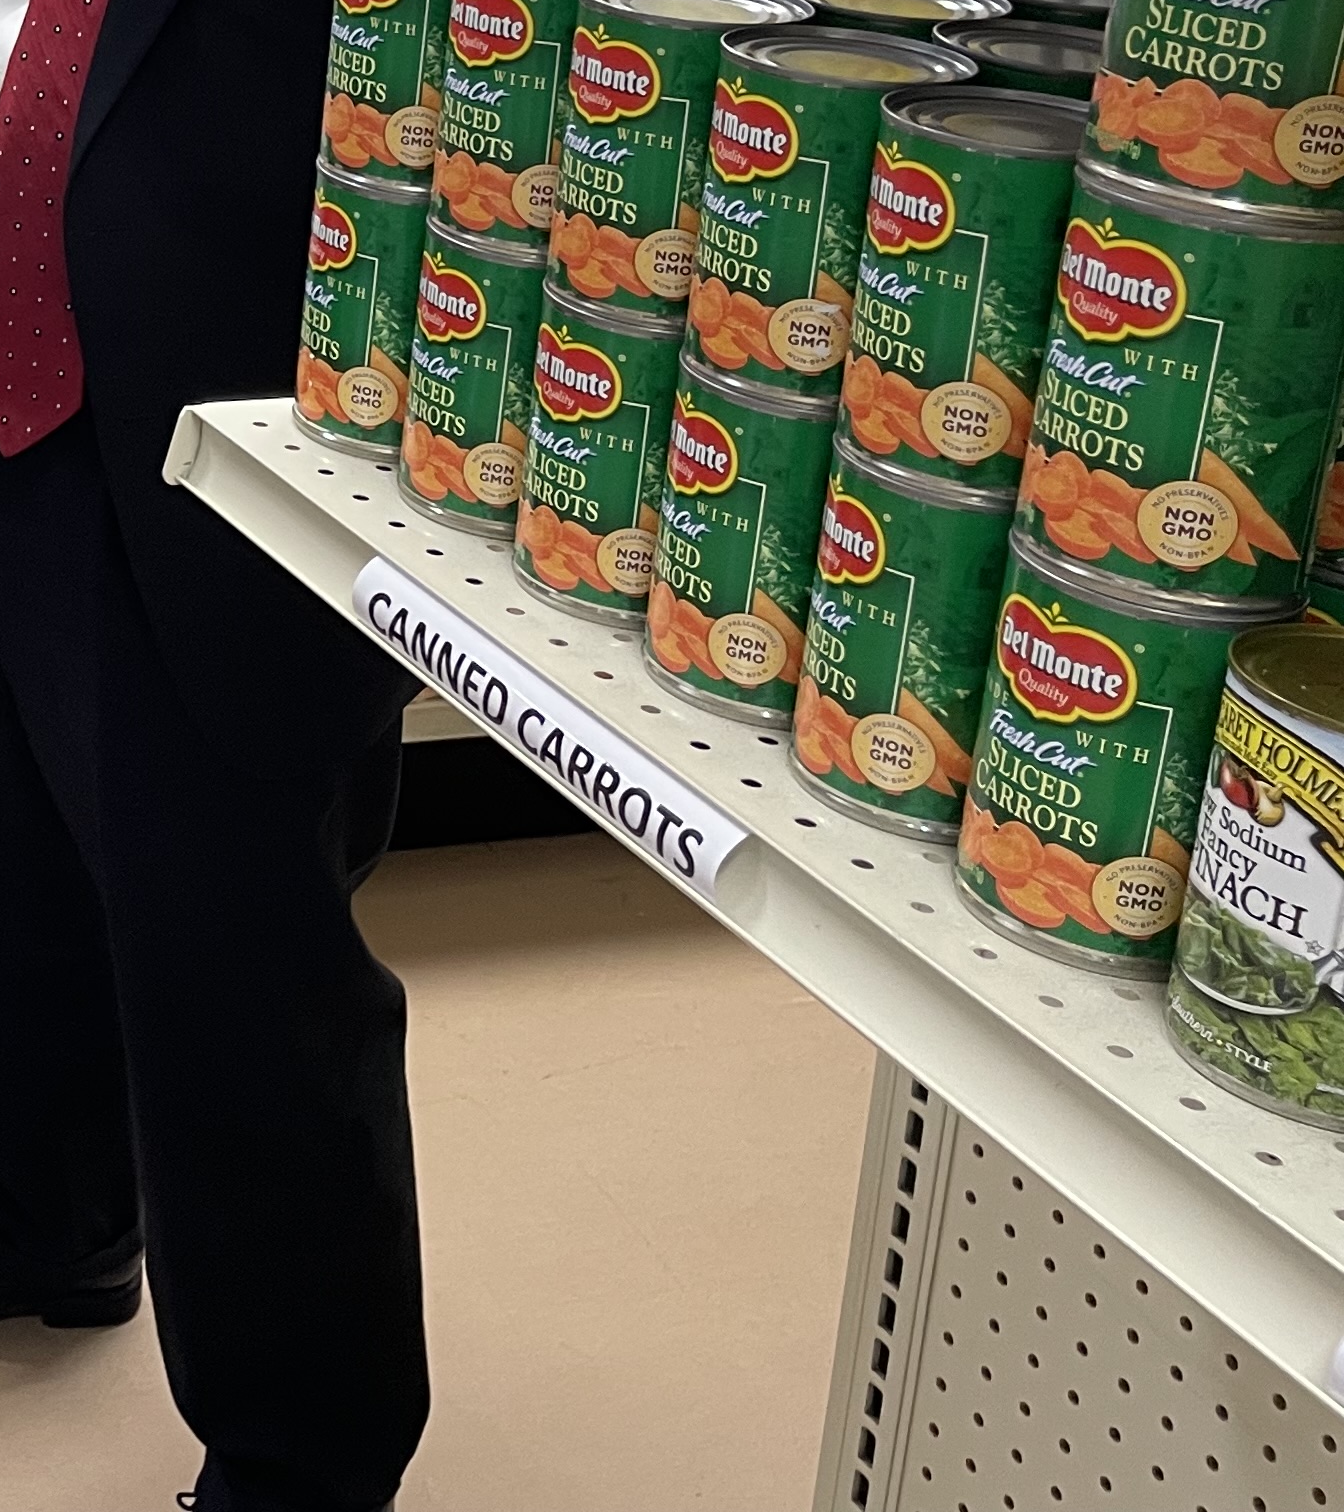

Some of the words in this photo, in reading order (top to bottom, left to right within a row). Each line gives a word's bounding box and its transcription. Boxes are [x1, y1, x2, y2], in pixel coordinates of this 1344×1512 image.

[370, 17, 417, 37] WITH
[465, 5, 524, 41] Monte
[1125, 25, 1285, 91] CARROTS
[493, 69, 546, 90] WITH
[586, 60, 650, 96] Monte
[578, 85, 612, 109] Quality
[617, 127, 673, 150] WITH
[726, 114, 787, 156] Monte
[906, 261, 969, 291] WITH
[1062, 243, 1083, 276] Del
[1084, 257, 1173, 312] Monte
[1073, 291, 1118, 325] Quality
[789, 321, 831, 338] NON
[1124, 348, 1198, 382] WITH
[944, 405, 989, 425] NON
[1043, 368, 1129, 432] SLICED
[941, 420, 988, 438] GMO
[1032, 395, 1145, 472] CARROTS
[1162, 522, 1212, 541] GMO
[1165, 506, 1215, 527] NON
[725, 646, 766, 665] GMO
[728, 635, 767, 655] NON
[1003, 616, 1028, 661] Del
[1031, 637, 1124, 699] Monte
[1018, 668, 1069, 708] Quality
[367, 591, 509, 726] CANNED
[517, 708, 704, 879] CARROTS
[872, 731, 914, 757] NON
[1075, 730, 1150, 765] WITH
[869, 747, 913, 770] GMO
[987, 738, 1082, 809] SLICED
[976, 757, 1099, 849] CARROTS
[1219, 805, 1306, 873] Sodium
[1115, 895, 1163, 911] GMO
[1118, 881, 1165, 897] NON
[1225, 1038, 1273, 1074] STYLE
